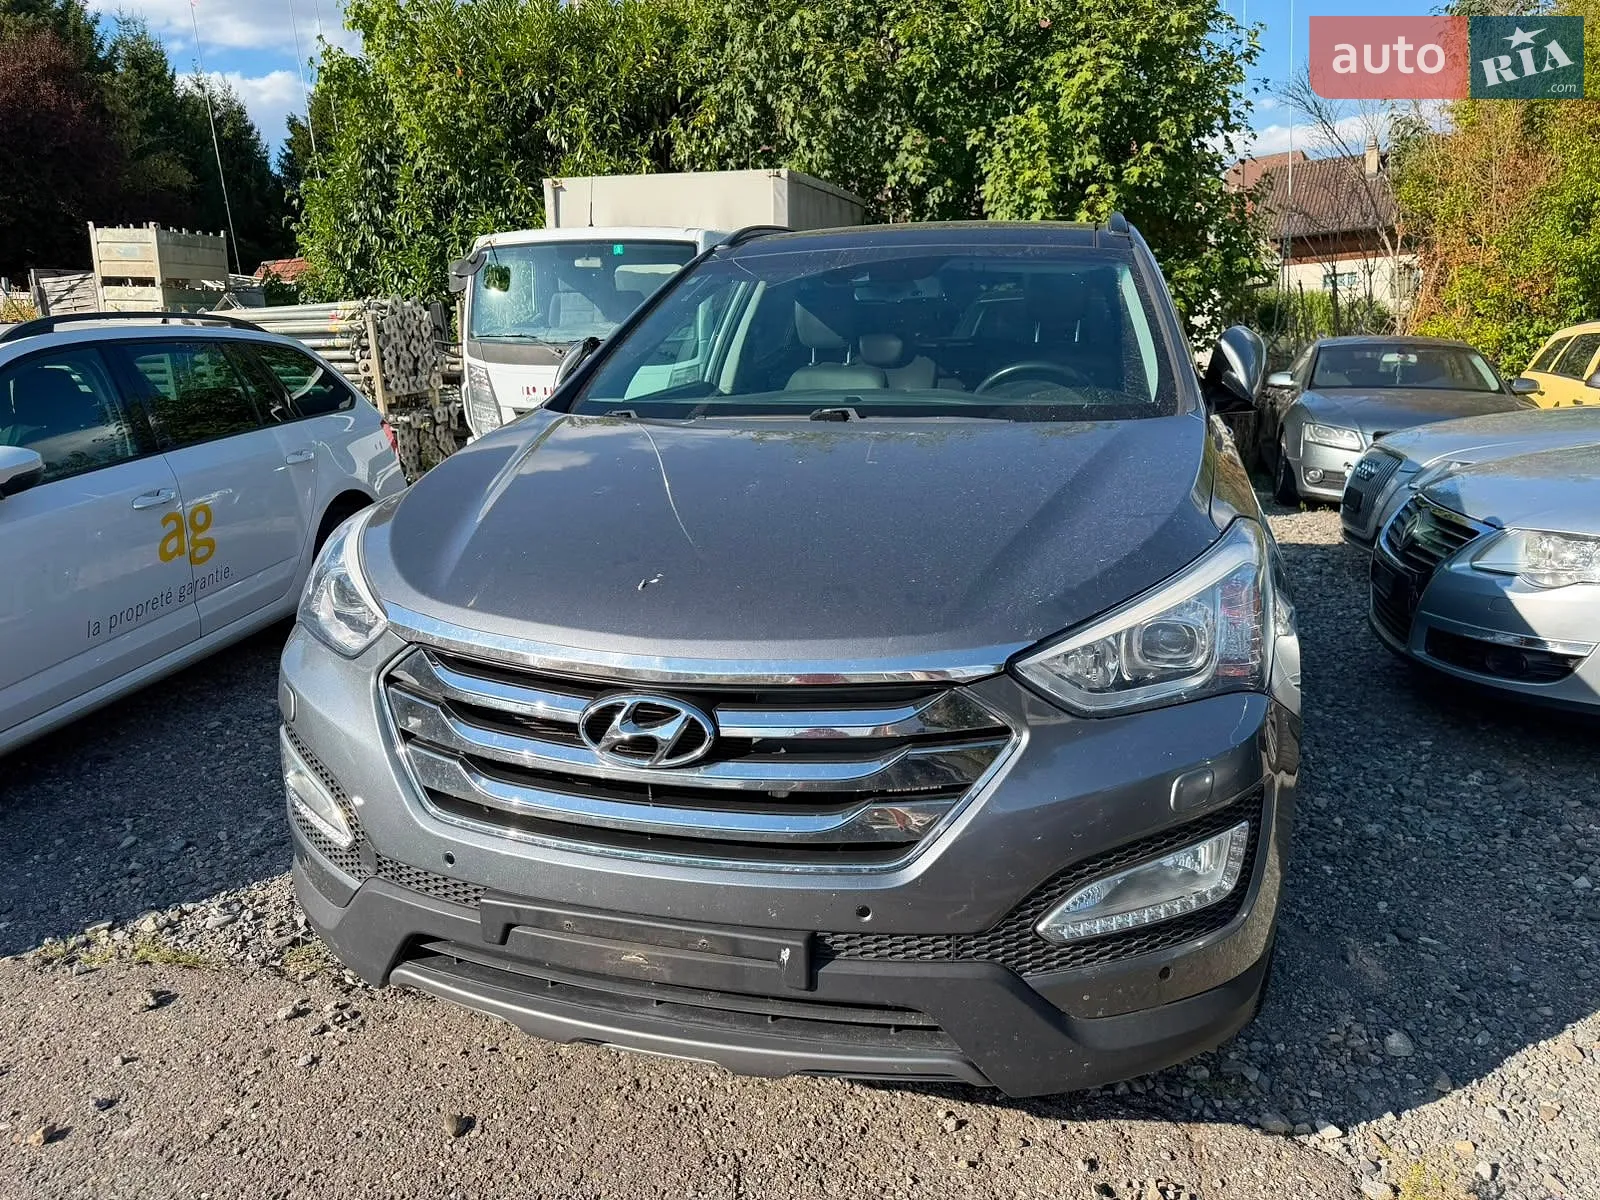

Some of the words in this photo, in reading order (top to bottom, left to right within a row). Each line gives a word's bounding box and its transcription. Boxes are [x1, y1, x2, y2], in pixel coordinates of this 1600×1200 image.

[158, 503, 216, 566] ag
[86, 620, 101, 639] la
[108, 586, 173, 634] propreté
[178, 564, 234, 603] garantie.
